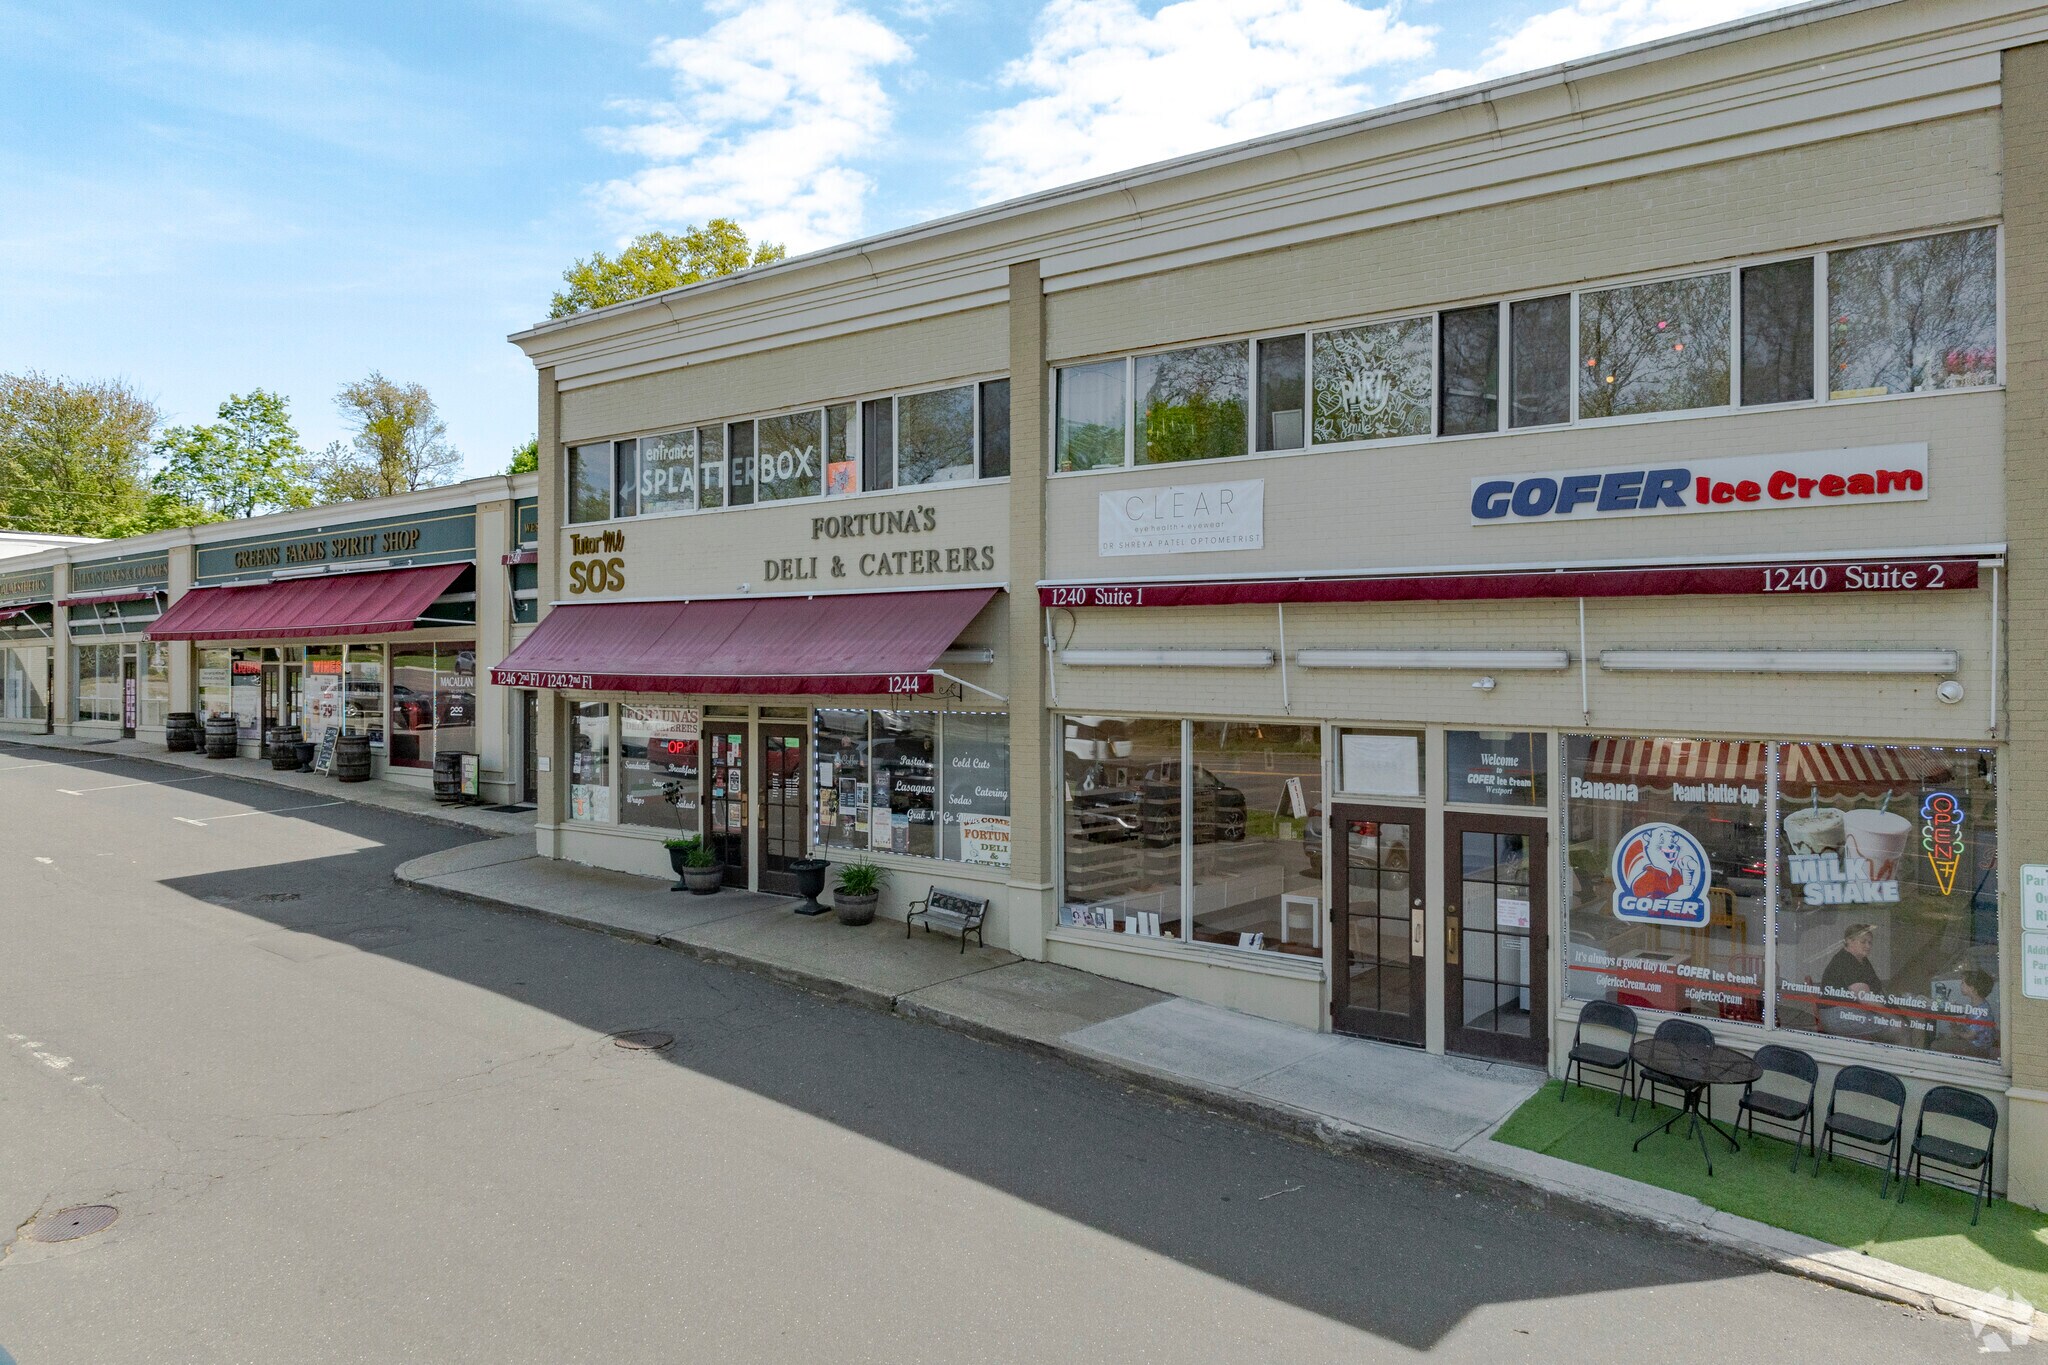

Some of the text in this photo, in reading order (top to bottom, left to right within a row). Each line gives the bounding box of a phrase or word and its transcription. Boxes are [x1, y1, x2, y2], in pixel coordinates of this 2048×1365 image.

[1340, 414, 1375, 439] Smile
[646, 440, 694, 462] entrance
[1471, 468, 1924, 519] GOFER Ice Cream
[1125, 488, 1235, 521] CLEAR
[811, 505, 937, 540] FORTUNA'S
[1134, 526, 1149, 534] eye
[1151, 523, 1178, 532] health
[1187, 520, 1225, 530] eyewear
[234, 528, 420, 569] GREENS FARMS SPIRIT SHOP
[569, 533, 602, 556] Tutor
[1103, 534, 1260, 550] DR SHREYA PATEL OPTOMETRIST
[763, 544, 995, 583] DELI & CATERERS
[569, 557, 625, 594] SOS
[1763, 564, 1945, 593] 1240 Suite 2
[1051, 587, 1143, 606] 1240 Suite 1
[313, 660, 343, 674] WINES
[440, 676, 474, 687] MACALLAN
[497, 671, 516, 685] 1246
[547, 674, 567, 688] 1242
[887, 675, 920, 694] 1244
[668, 763, 697, 776] Breakfast
[952, 756, 991, 769] Cold Cuts
[1481, 753, 1519, 767] Welcome
[894, 780, 936, 796] Lasagnas
[1467, 773, 1531, 787] GOFER Ice Cream
[1570, 776, 1639, 802] Banana
[948, 793, 972, 806] Sodas
[974, 785, 1009, 801] Catering
[1486, 785, 1513, 795] Westport
[1673, 782, 1760, 808] Peanut Butter Cup
[906, 808, 926, 822] Grab
[943, 811, 954, 824] Go
[1932, 797, 1953, 859] OPEN
[980, 843, 1009, 853] DELI
[989, 852, 999, 860] &
[1790, 858, 1870, 884] MILK
[1803, 879, 1901, 906] SHAKE
[1621, 896, 1699, 914] GOFER
[1574, 950, 1587, 963] It's
[1588, 952, 1616, 967] always
[1623, 957, 1643, 971] good
[1643, 959, 1658, 974] day
[1676, 964, 1711, 980] GOFER
[1712, 969, 1725, 982] Ice
[1726, 971, 1757, 985] Cream!
[1781, 980, 1989, 1017] Premium, Shakes, Cakes, Sundaes & Fun Days
[1839, 1011, 1934, 1032] Delivery Take Out Dine In
